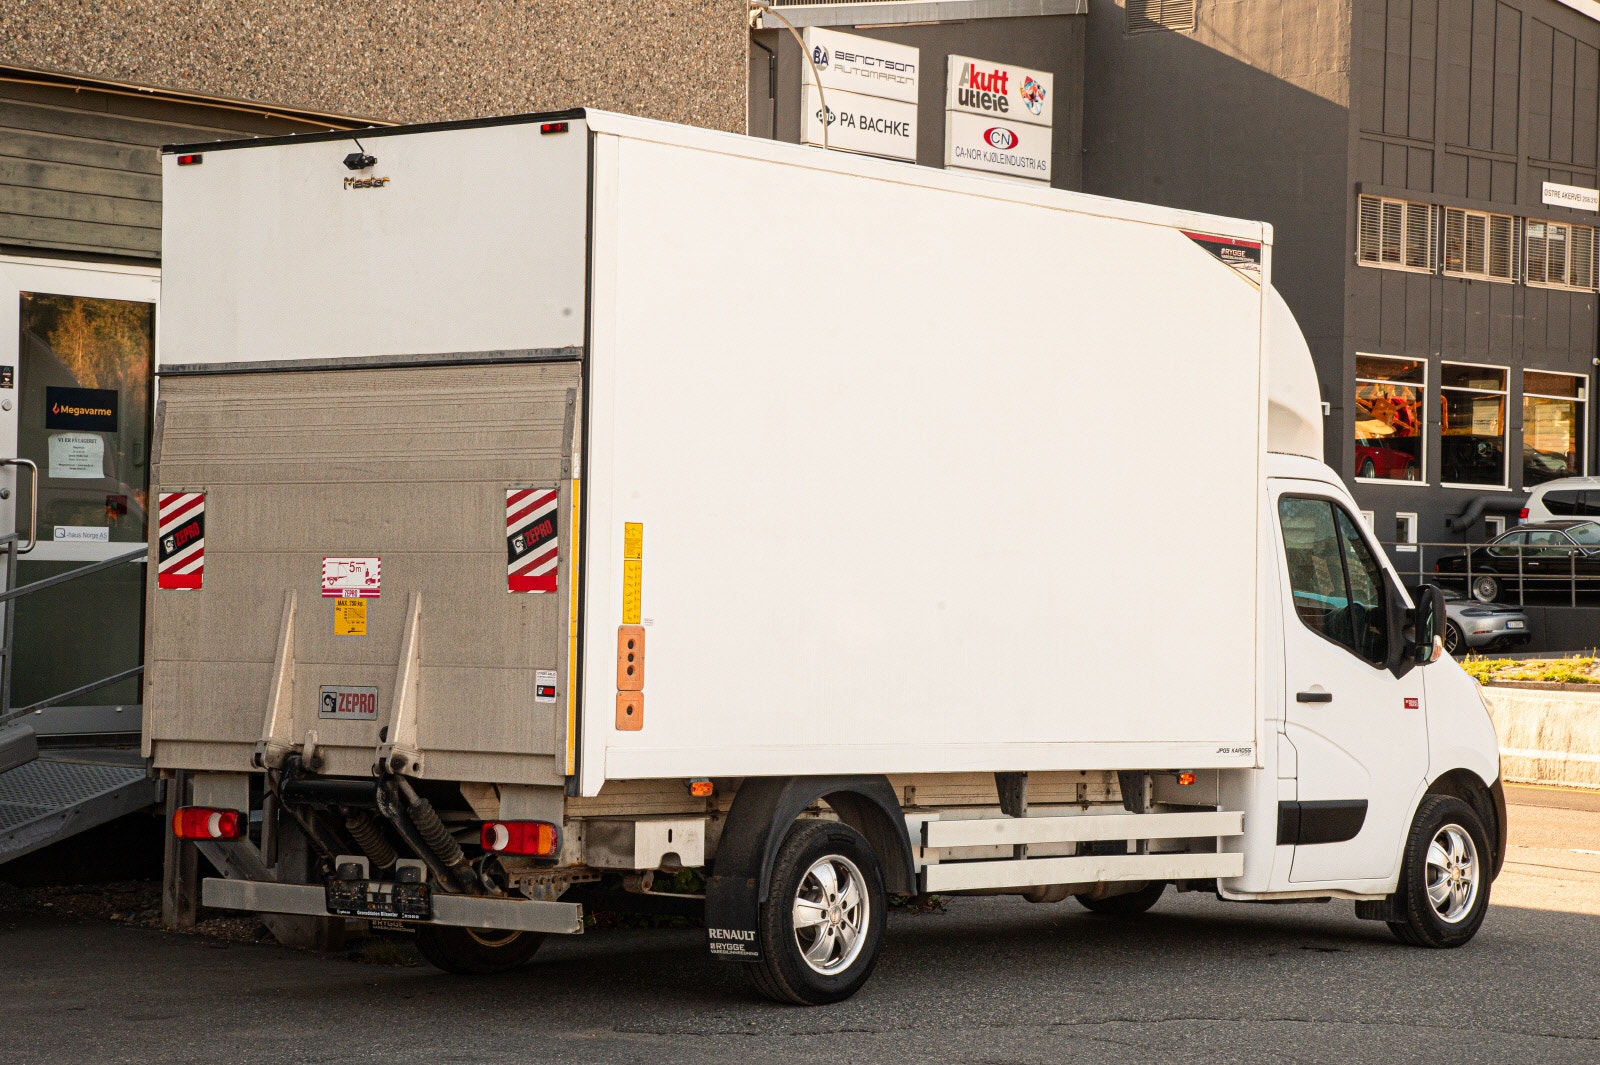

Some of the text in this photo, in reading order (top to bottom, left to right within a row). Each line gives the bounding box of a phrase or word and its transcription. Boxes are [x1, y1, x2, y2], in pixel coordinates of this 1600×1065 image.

[834, 50, 915, 73] BENGTSON
[834, 64, 915, 86] AUTOMARIN
[959, 62, 1009, 95] Akutt
[958, 88, 1009, 113] utleie
[840, 112, 856, 128] PA
[859, 115, 910, 137] BACHKE
[991, 131, 1011, 146] CN
[955, 146, 1047, 171] CA-NOR KJØLEINDUSTRI AS
[343, 174, 390, 190] Master
[60, 405, 112, 416] Megavarme
[174, 521, 200, 547] ZEPRO
[524, 519, 553, 547] ZEPRO
[338, 692, 375, 713] ZEPRO
[709, 928, 756, 941] RENAULT
